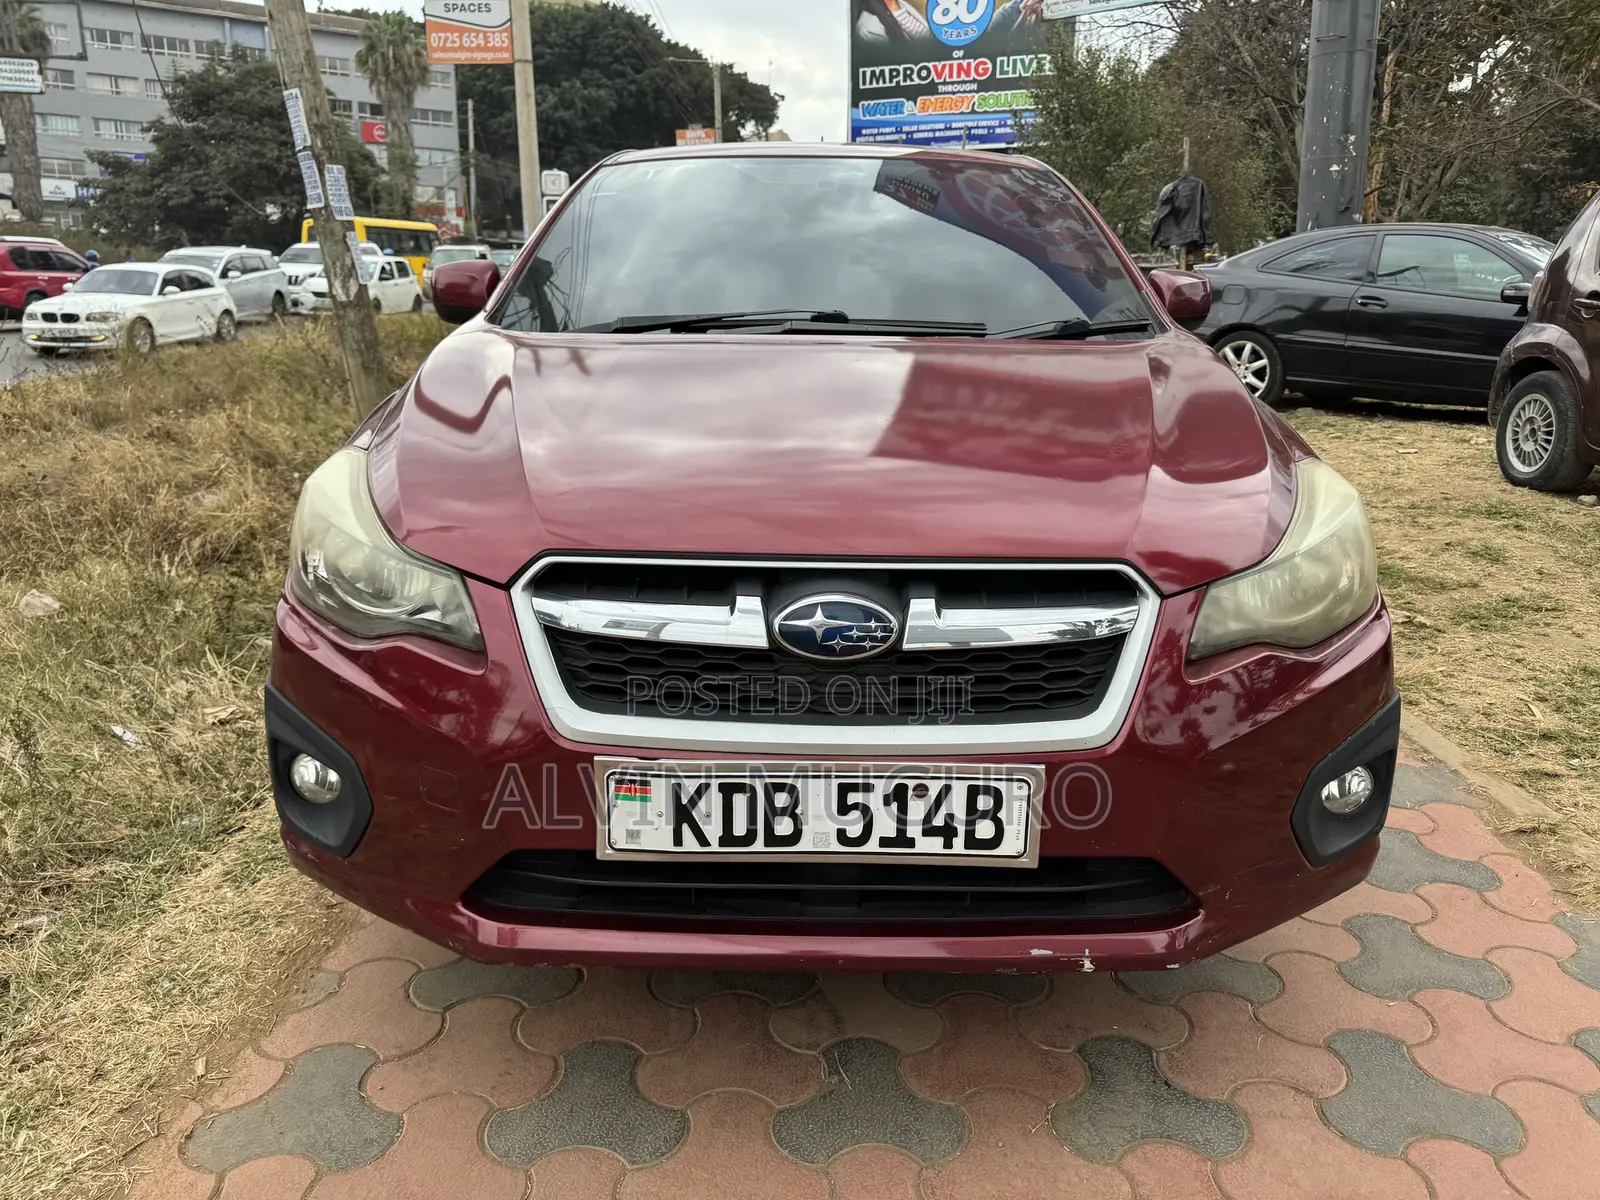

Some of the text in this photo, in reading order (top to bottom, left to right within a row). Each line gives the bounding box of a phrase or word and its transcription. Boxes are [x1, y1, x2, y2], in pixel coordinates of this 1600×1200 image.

[443, 3, 492, 13] SPACES
[430, 32, 509, 48] 0725 654 385
[942, 26, 978, 40] YEARS
[952, 50, 965, 58] OF
[860, 55, 1053, 88] IMPROVING LIVE
[937, 83, 978, 93] THROUGH
[860, 100, 906, 118] WATER
[918, 95, 975, 114] ENERGY
[671, 781, 804, 848] KDB
[835, 781, 1006, 850] 514B
